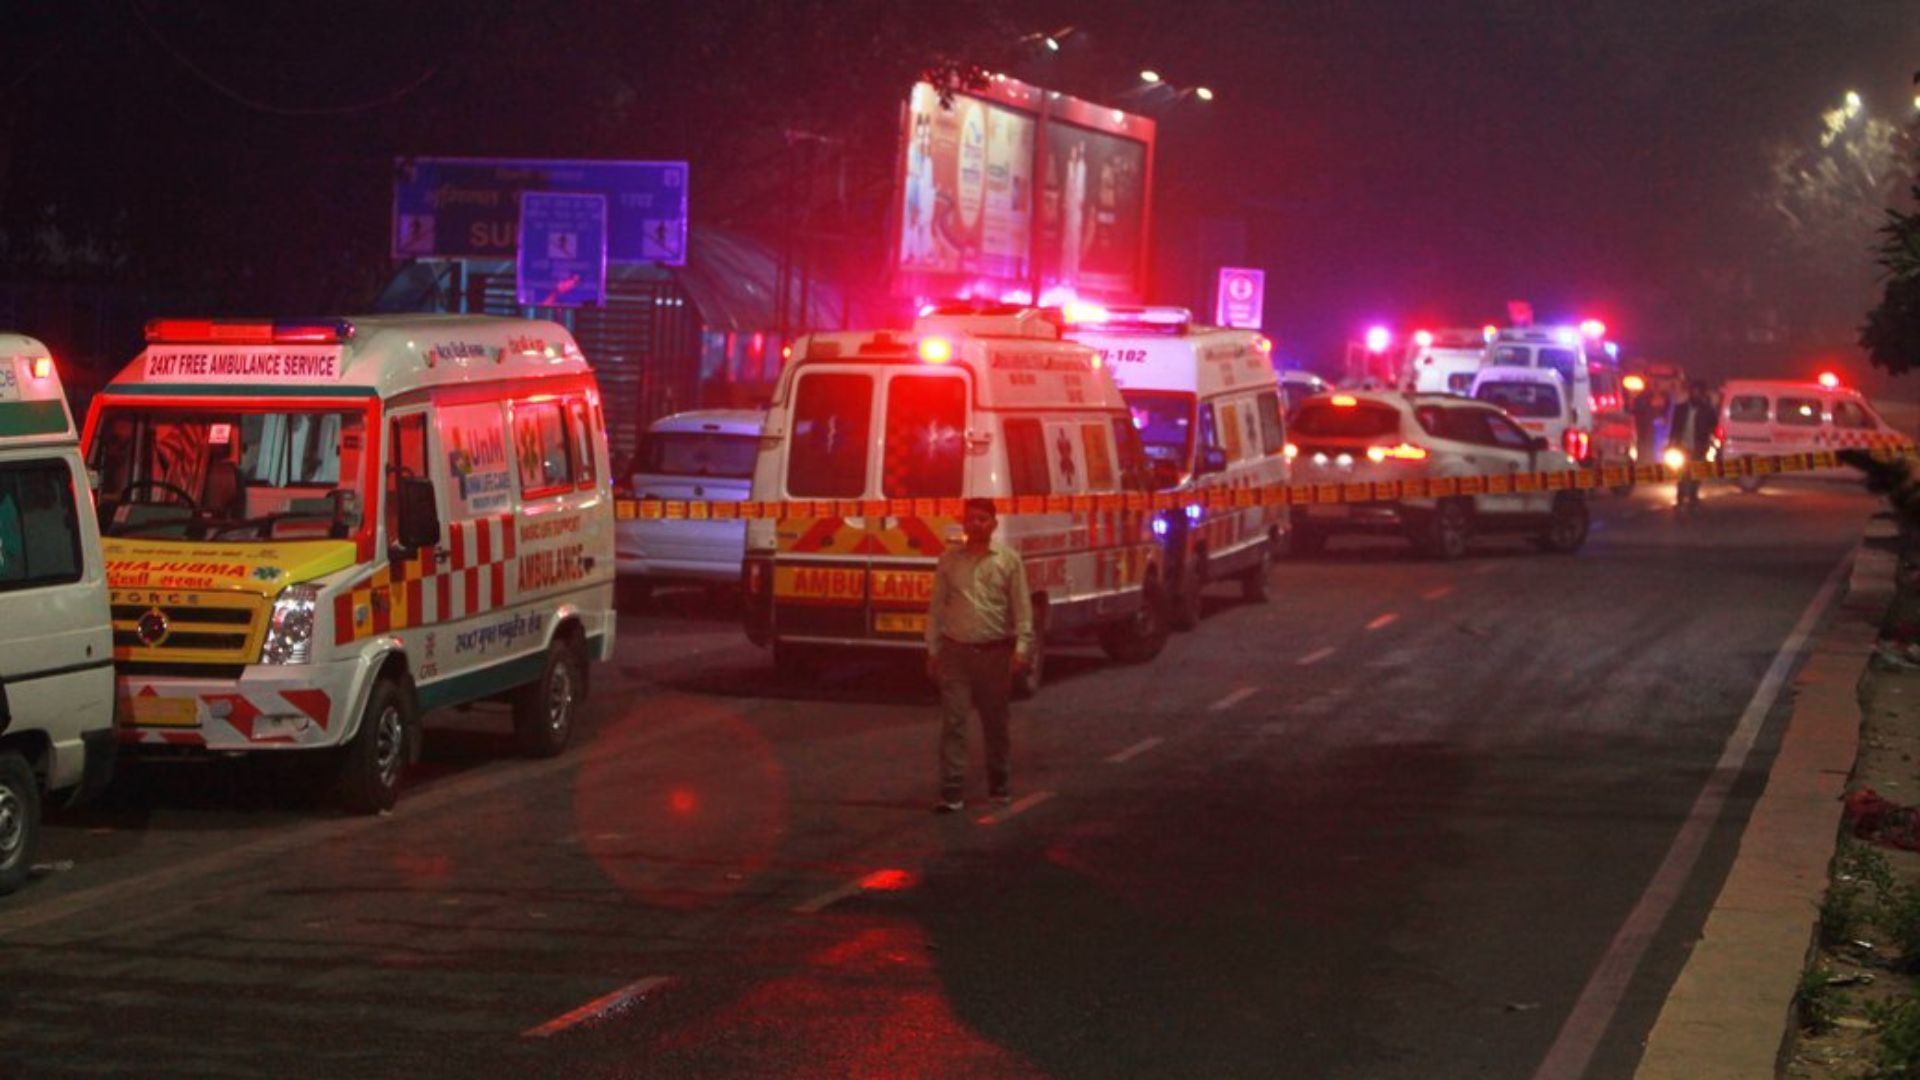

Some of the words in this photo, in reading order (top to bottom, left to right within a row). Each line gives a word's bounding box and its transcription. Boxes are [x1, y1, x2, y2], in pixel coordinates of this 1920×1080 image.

[470, 222, 513, 247] SU
[149, 355, 176, 375] 24X7
[178, 355, 207, 375] FREE
[208, 356, 279, 376] AMBULANCE
[282, 357, 337, 376] SERVICE
[518, 543, 584, 593] AMBULANCE
[793, 570, 931, 597] AMBULANC
[111, 592, 198, 604] FORCE
